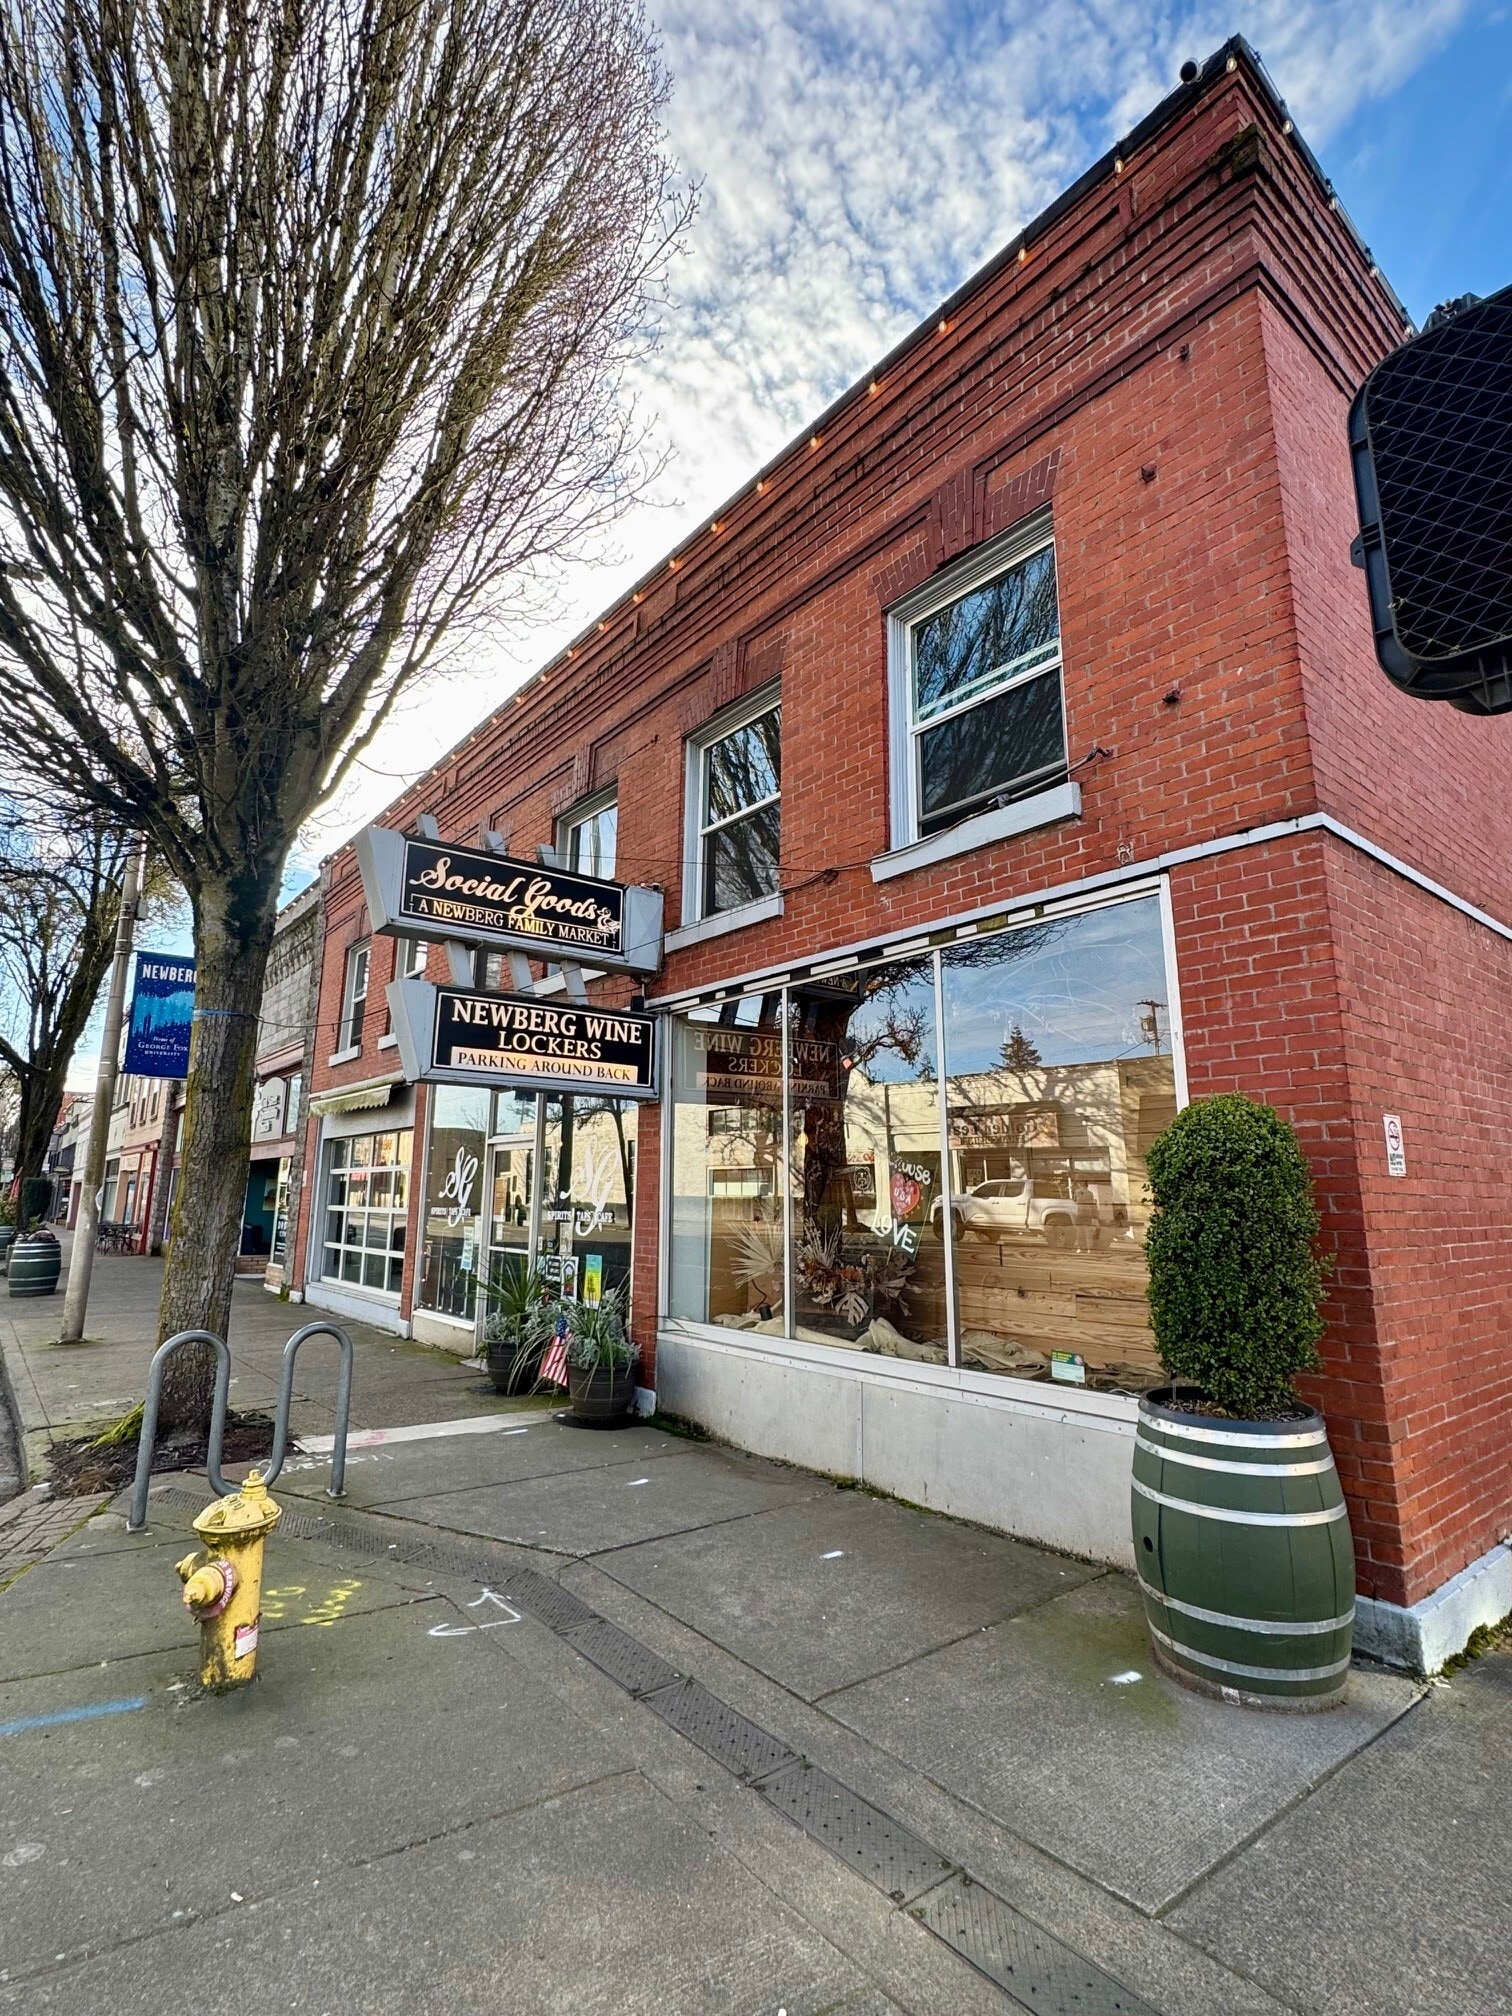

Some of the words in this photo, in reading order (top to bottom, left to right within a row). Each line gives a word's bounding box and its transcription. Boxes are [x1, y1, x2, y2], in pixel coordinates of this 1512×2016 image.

[409, 857, 525, 903] Social
[510, 877, 598, 919] Goods
[418, 898, 429, 913] A
[432, 900, 504, 927] NEWBERG
[508, 913, 556, 936] FAMILY
[558, 924, 610, 946] MARKET
[451, 998, 577, 1036] NEWBERG
[585, 1015, 642, 1044] WINE
[457, 1051, 527, 1070] PARKING
[530, 1060, 594, 1078] AROUND
[596, 1066, 632, 1081] BACK
[498, 1031, 602, 1059] LOCKERS
[547, 1210, 572, 1221] SPIRITS
[576, 1211, 591, 1222] TAPS
[597, 1211, 613, 1223] CAFE
[870, 1208, 917, 1254] LOVE
[220, 1568, 233, 1608] SERVICE
